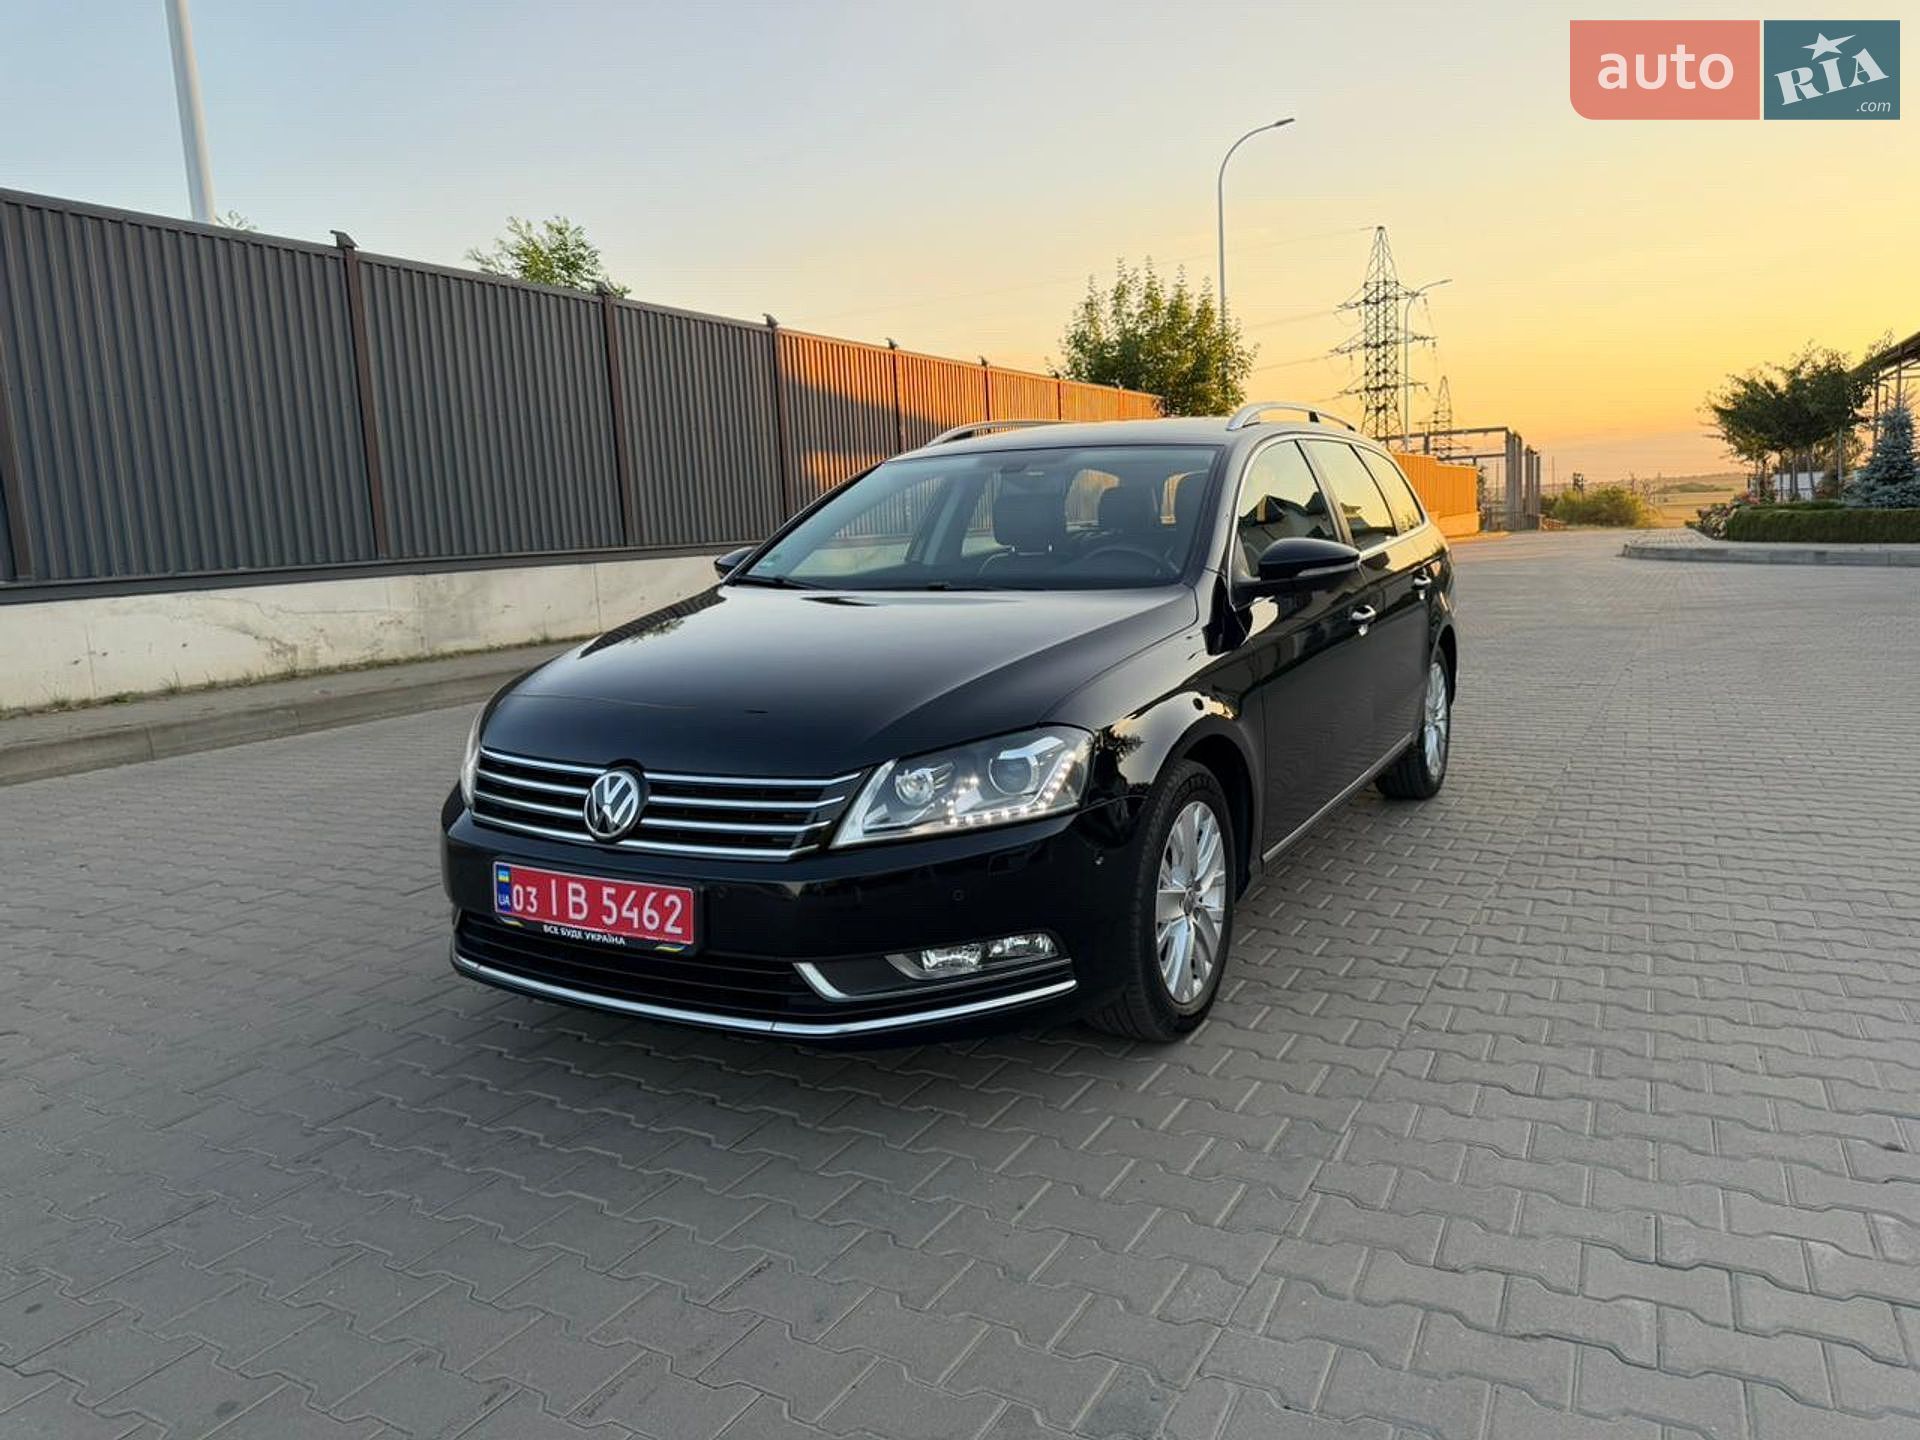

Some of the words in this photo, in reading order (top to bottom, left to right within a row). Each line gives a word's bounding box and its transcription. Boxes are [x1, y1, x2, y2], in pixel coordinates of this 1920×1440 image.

[498, 893, 511, 907] UA
[512, 883, 538, 914] 03
[550, 878, 589, 921] IB
[601, 885, 684, 935] 5462
[584, 931, 627, 945] УКРАЇНА
